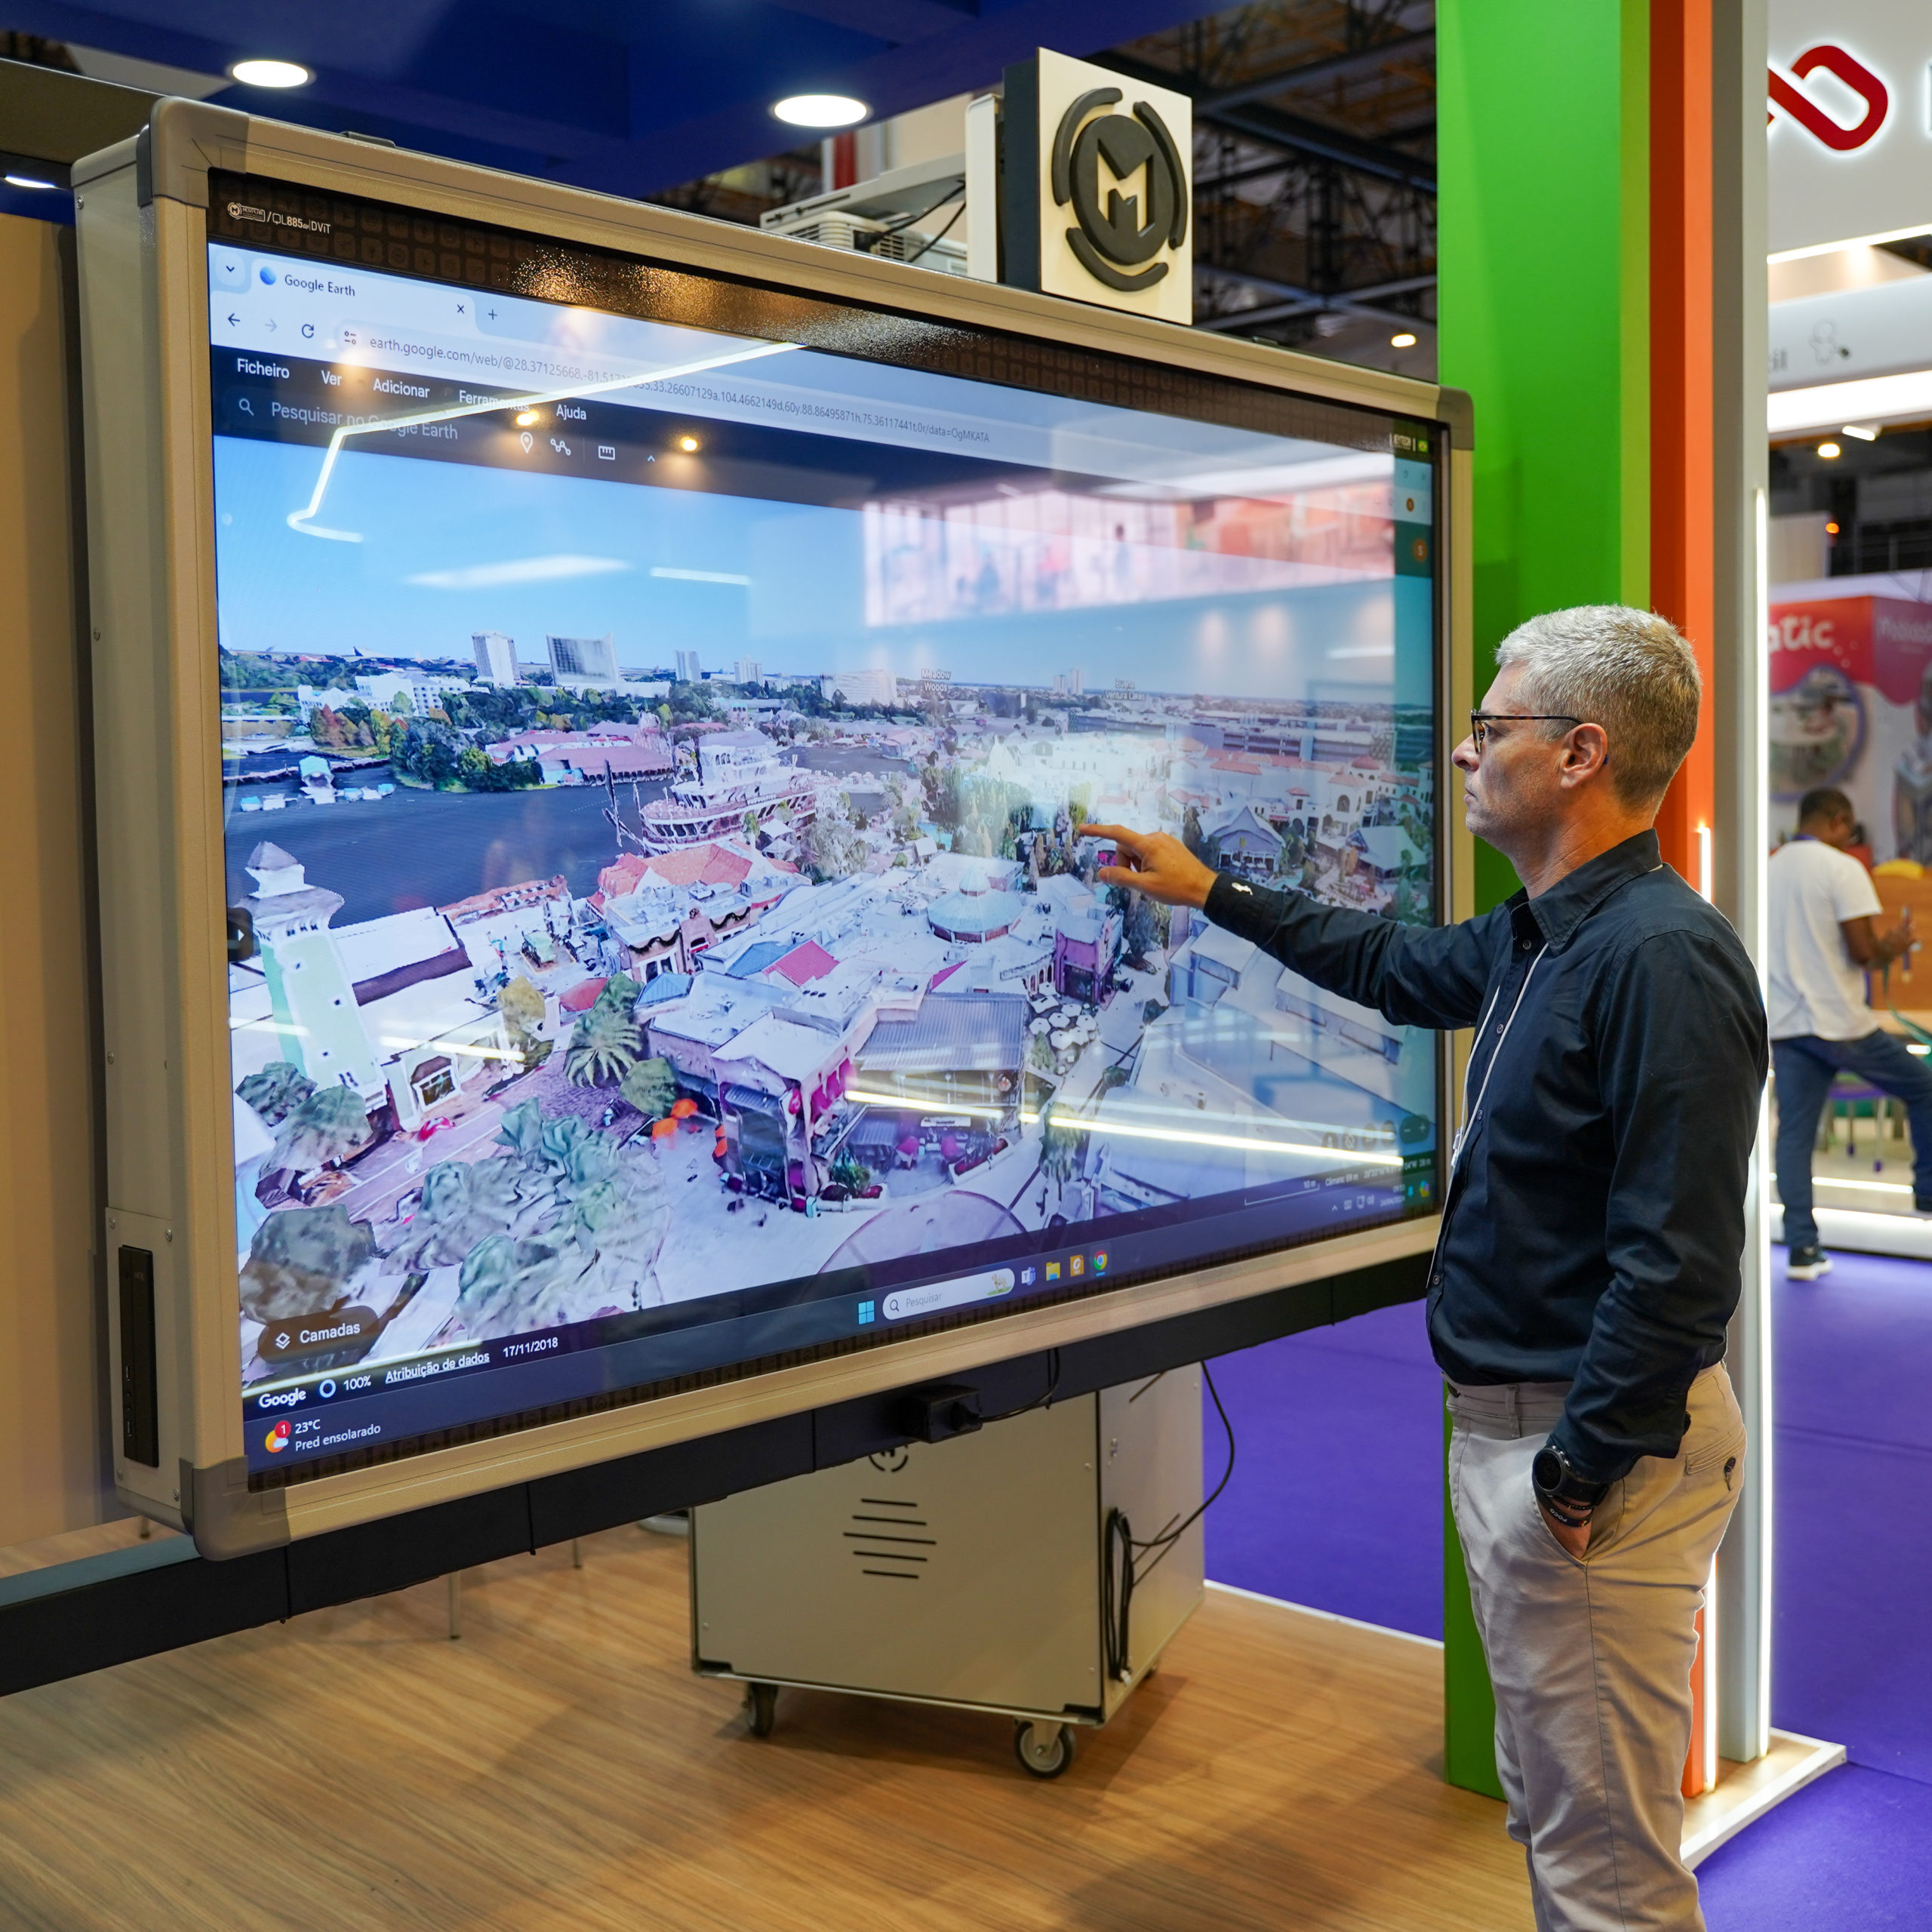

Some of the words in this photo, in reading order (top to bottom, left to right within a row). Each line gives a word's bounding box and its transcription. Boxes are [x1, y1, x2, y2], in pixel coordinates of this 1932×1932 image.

[285, 273, 325, 293] Google
[325, 279, 356, 297] Earth
[236, 357, 291, 380] Ficheiro
[321, 369, 343, 386] Ver
[373, 377, 431, 398] Adicionar
[458, 389, 531, 413] Ferrameas
[555, 403, 587, 421] Ajuda
[271, 400, 343, 428] Pesquisar
[346, 414, 365, 427] no
[368, 414, 418, 438] Ggle
[421, 423, 459, 440] Earth
[921, 668, 952, 680] Meadow
[924, 681, 949, 693] Woods
[906, 1291, 943, 1310] Pesquisar
[299, 1320, 361, 1345] Camadas
[503, 1337, 559, 1358] 17/11/2018
[384, 1359, 440, 1385] Atribuição
[441, 1356, 457, 1374] de
[457, 1350, 491, 1369] dados
[342, 1374, 372, 1392] 100%
[258, 1387, 307, 1409] Google
[281, 1423, 287, 1434] 1
[294, 1418, 321, 1435] 23°C
[294, 1435, 321, 1452] Pred
[321, 1423, 382, 1447] ensolarado
